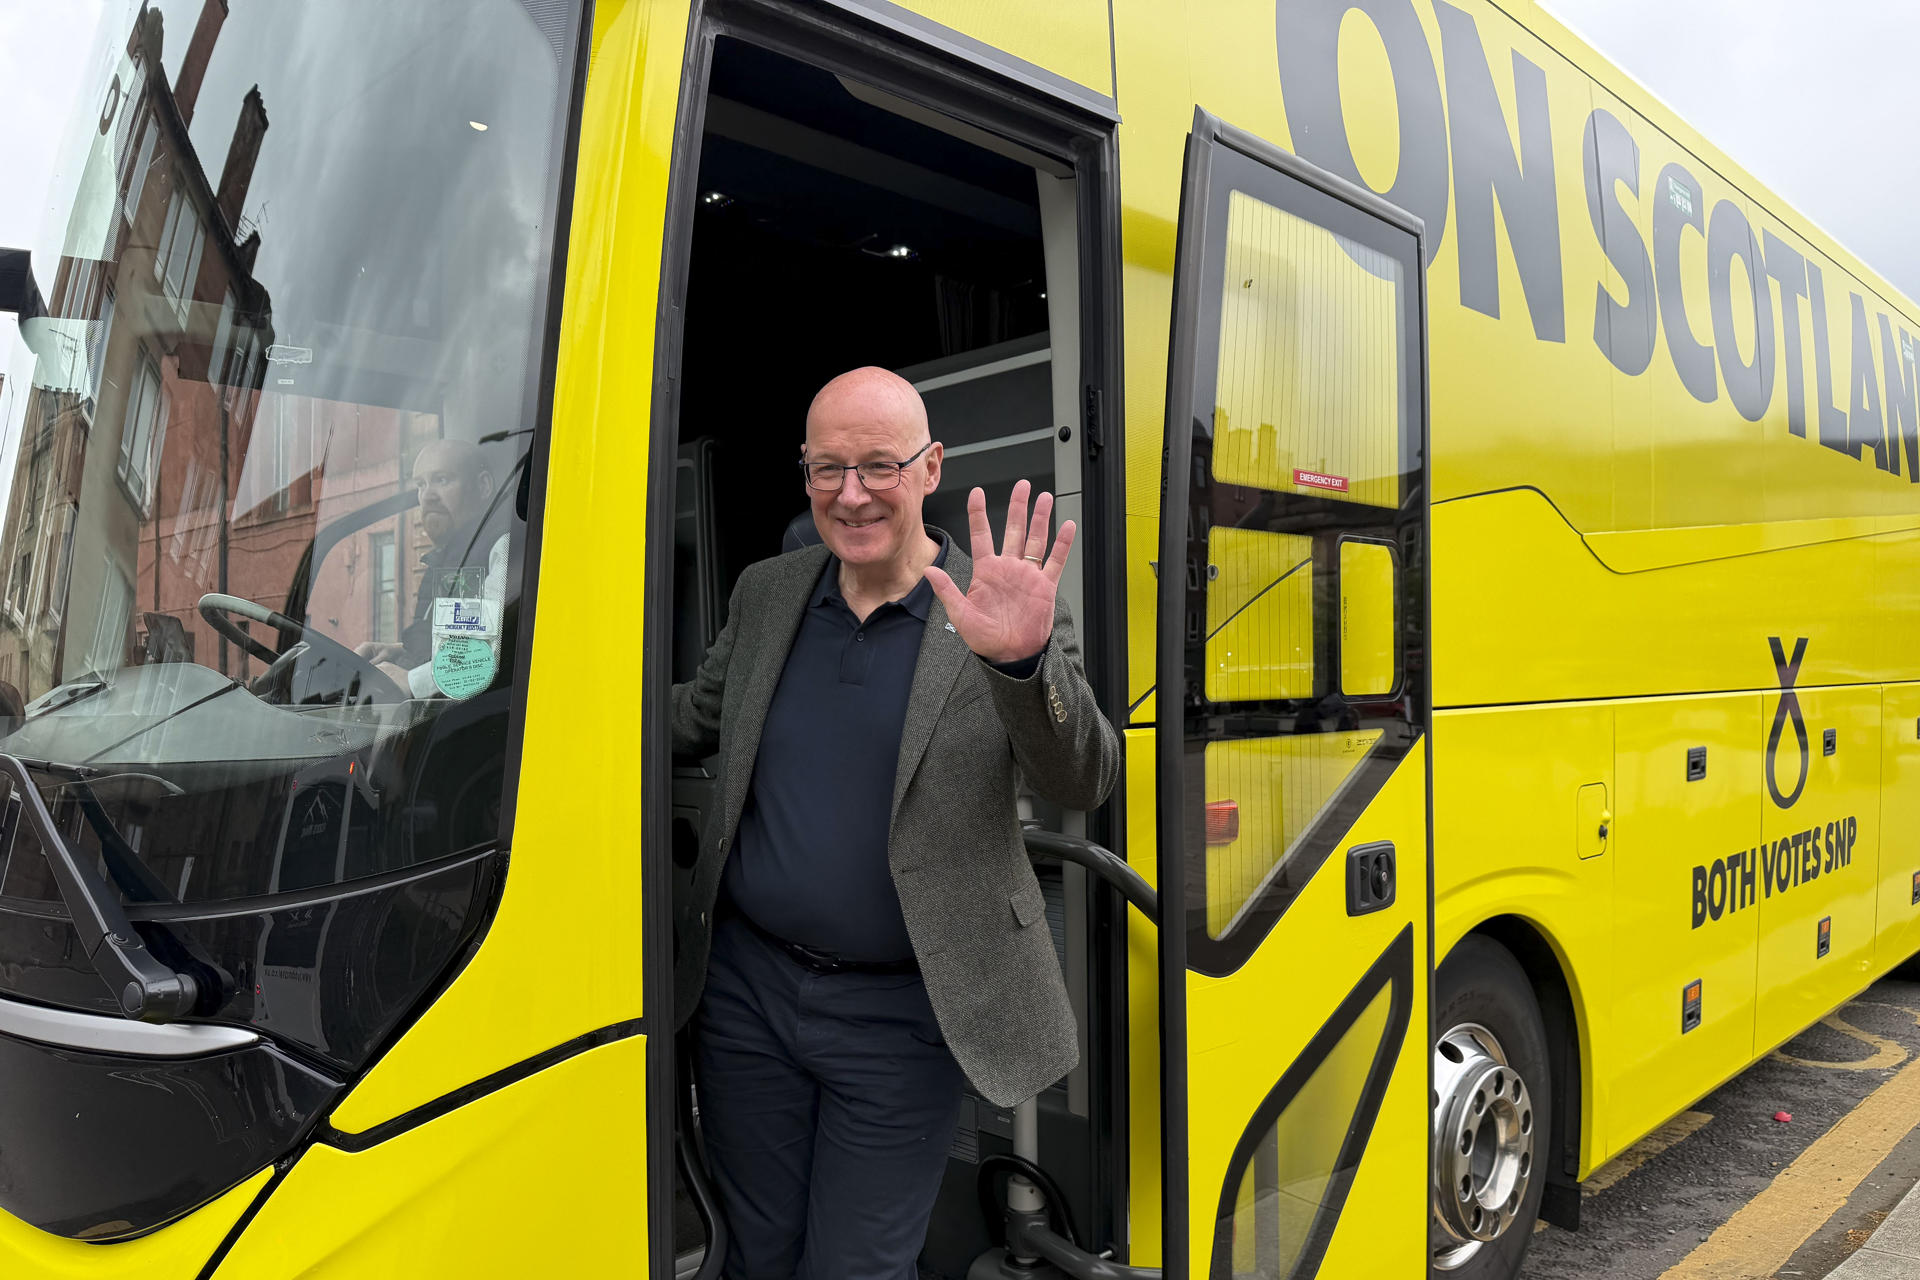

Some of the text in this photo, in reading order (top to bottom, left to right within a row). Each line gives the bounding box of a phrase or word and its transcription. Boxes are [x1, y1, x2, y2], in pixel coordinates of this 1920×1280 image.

[1275, 0, 1920, 483] ON SCOTLAN
[1299, 472, 1343, 487] EMERGENCY EXIT
[1691, 815, 1857, 930] BOTH VOTES SNP
